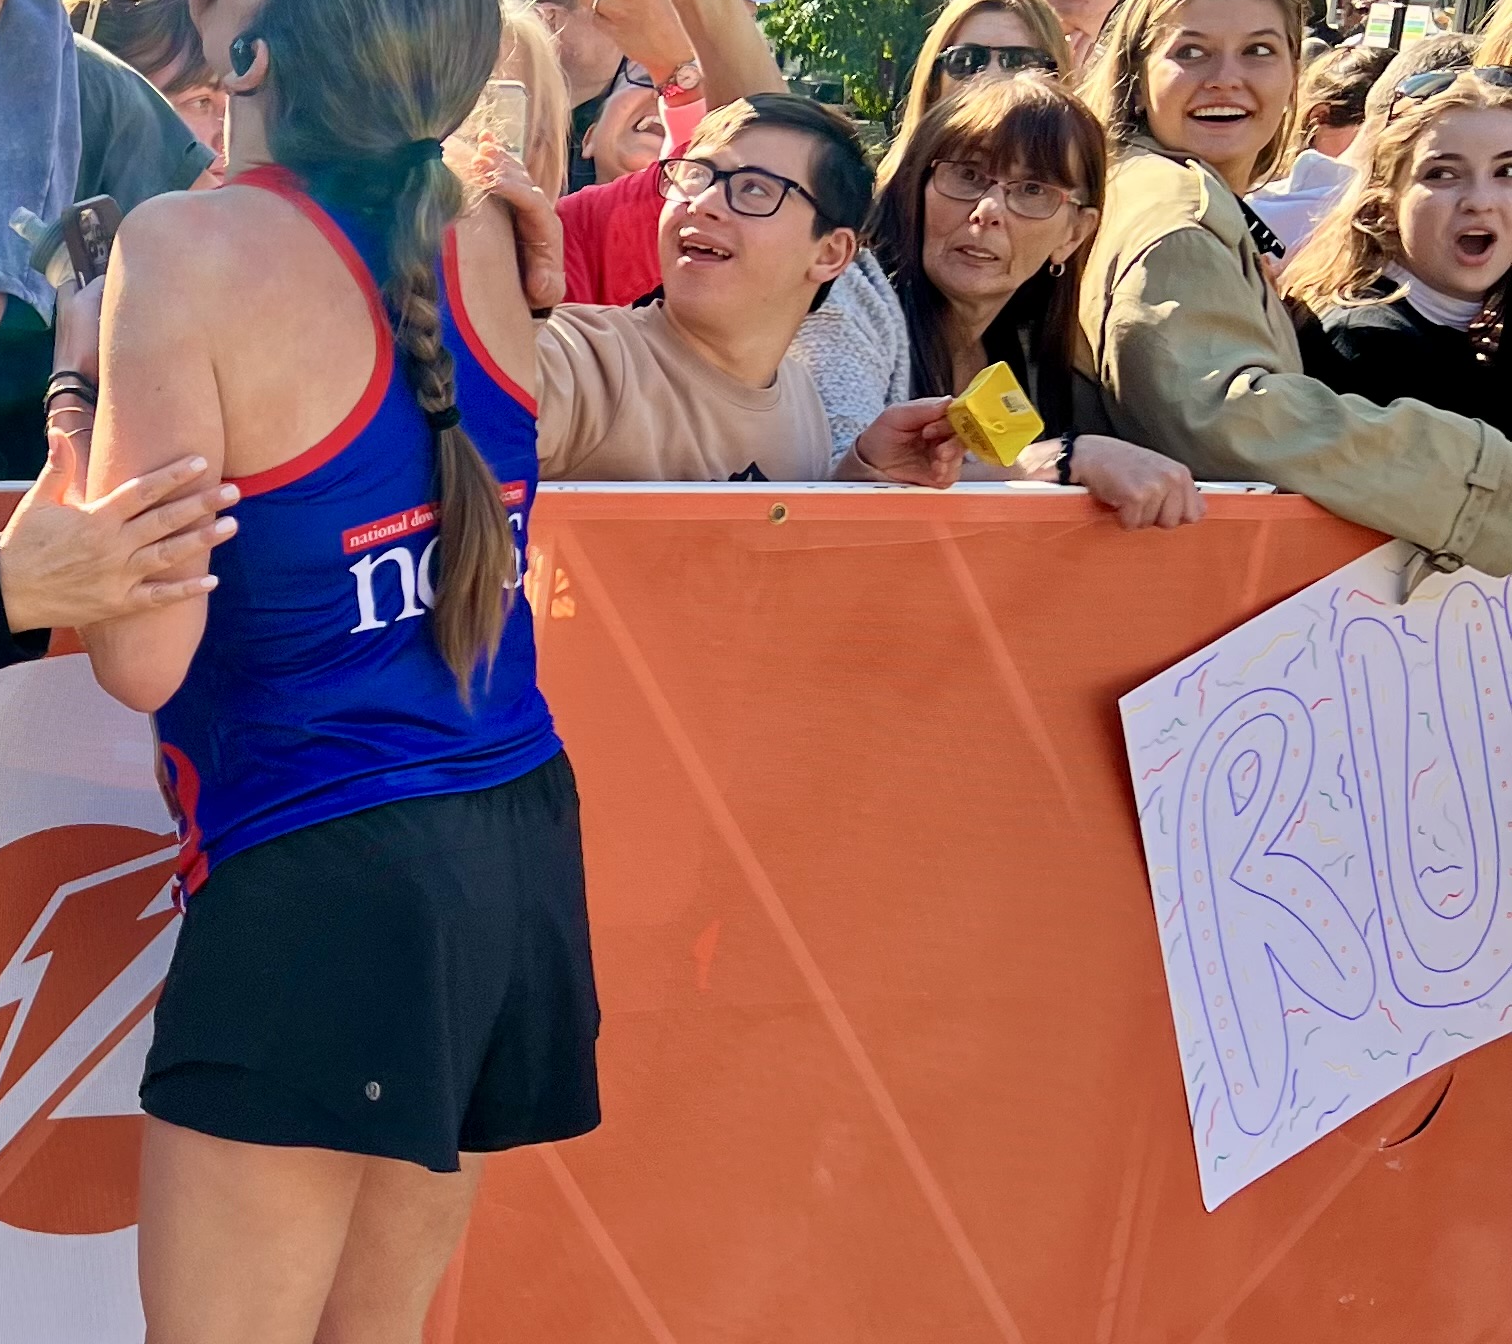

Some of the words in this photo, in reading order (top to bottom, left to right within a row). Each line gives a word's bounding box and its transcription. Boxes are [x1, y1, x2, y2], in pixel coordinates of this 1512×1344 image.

[349, 513, 408, 548] national
[410, 508, 438, 528] dow
[1176, 575, 1512, 1137] RU
